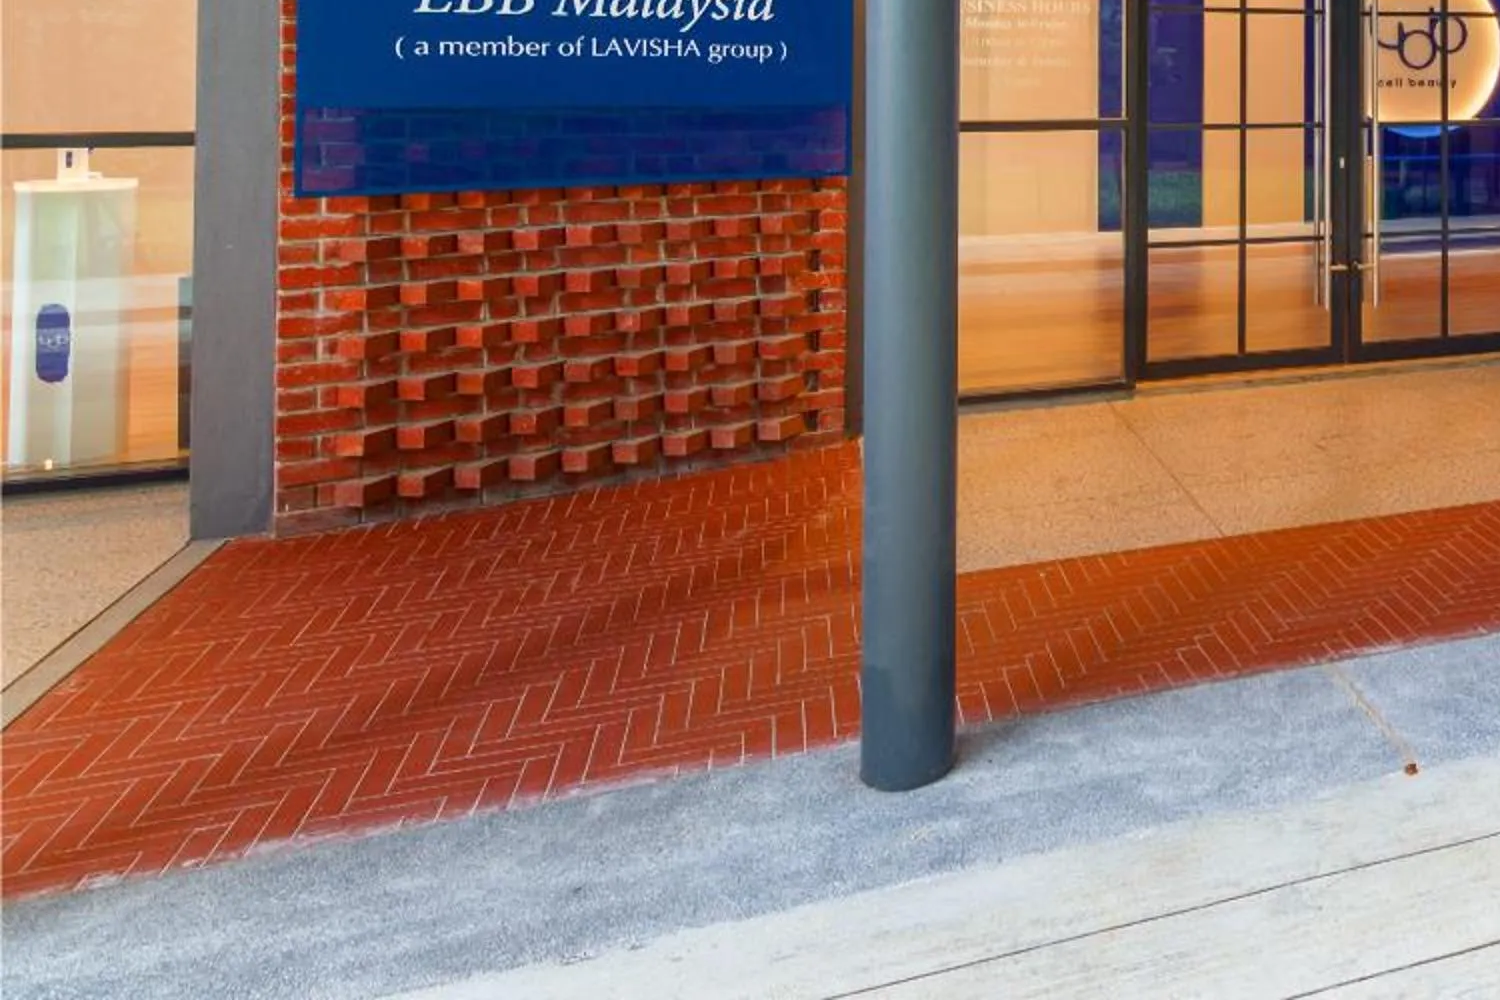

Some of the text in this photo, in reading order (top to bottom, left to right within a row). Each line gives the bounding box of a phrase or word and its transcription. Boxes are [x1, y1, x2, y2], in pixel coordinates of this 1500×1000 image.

[414, 41, 429, 56] a
[439, 35, 551, 57] member
[558, 36, 585, 57] of
[591, 37, 701, 58] LAVISHA
[708, 43, 773, 64] group
